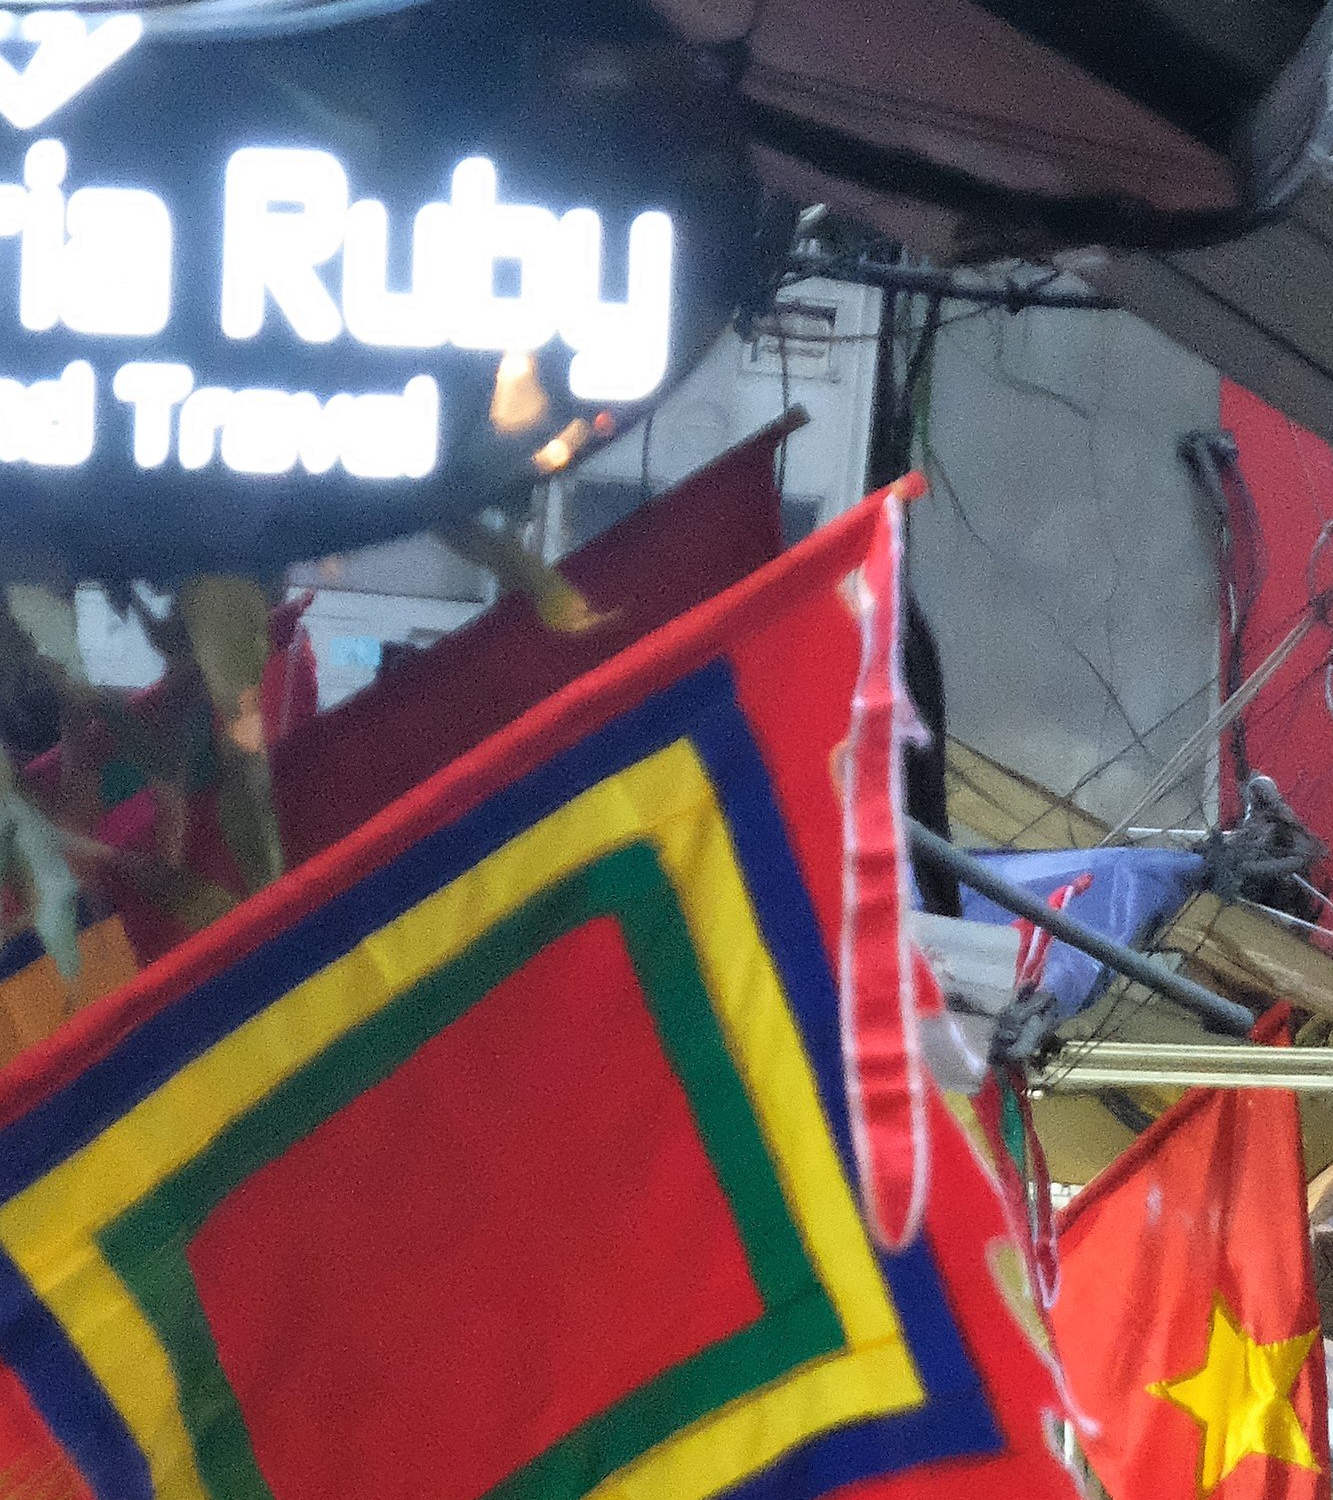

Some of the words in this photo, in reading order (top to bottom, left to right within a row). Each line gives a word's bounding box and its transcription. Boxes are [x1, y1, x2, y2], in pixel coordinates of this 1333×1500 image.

[0, 138, 172, 335] ia
[221, 146, 672, 401] Ruby
[113, 362, 440, 479] Travel
